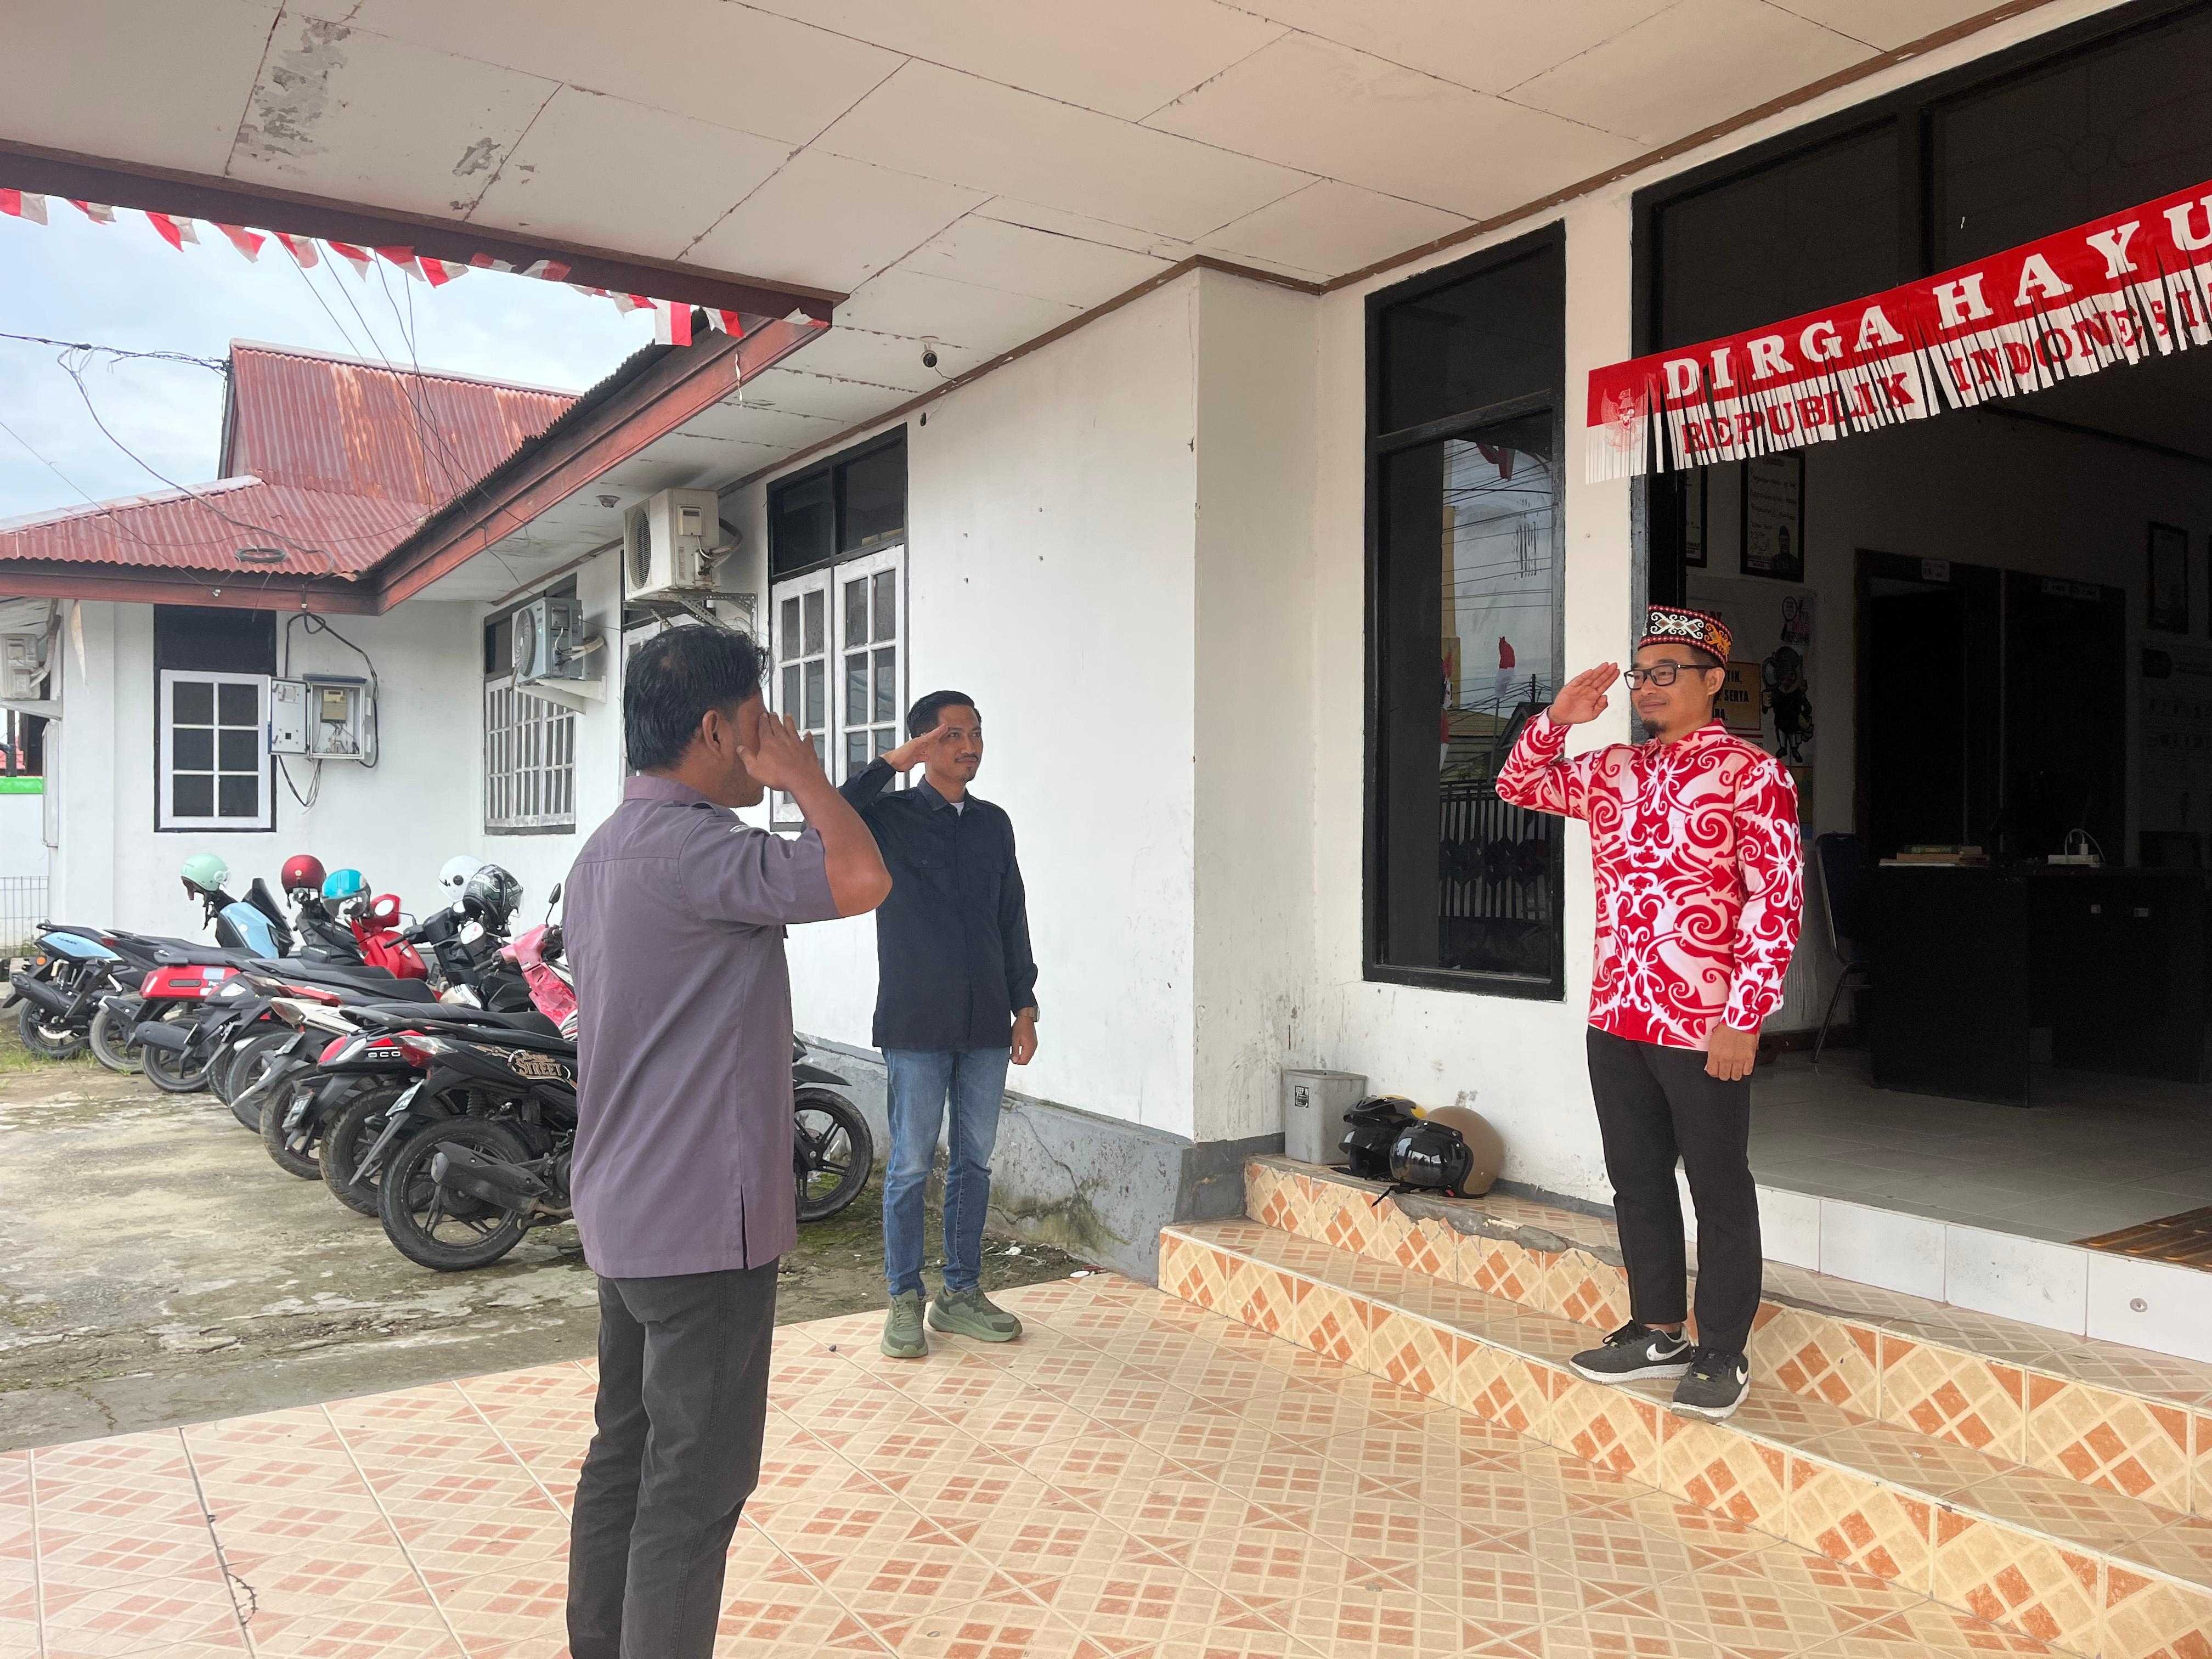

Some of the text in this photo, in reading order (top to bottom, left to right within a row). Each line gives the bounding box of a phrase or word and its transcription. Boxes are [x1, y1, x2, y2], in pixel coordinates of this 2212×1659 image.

[1681, 282, 2212, 454] REPUBLIK INDONESI
[1724, 689, 1749, 703] SERTA
